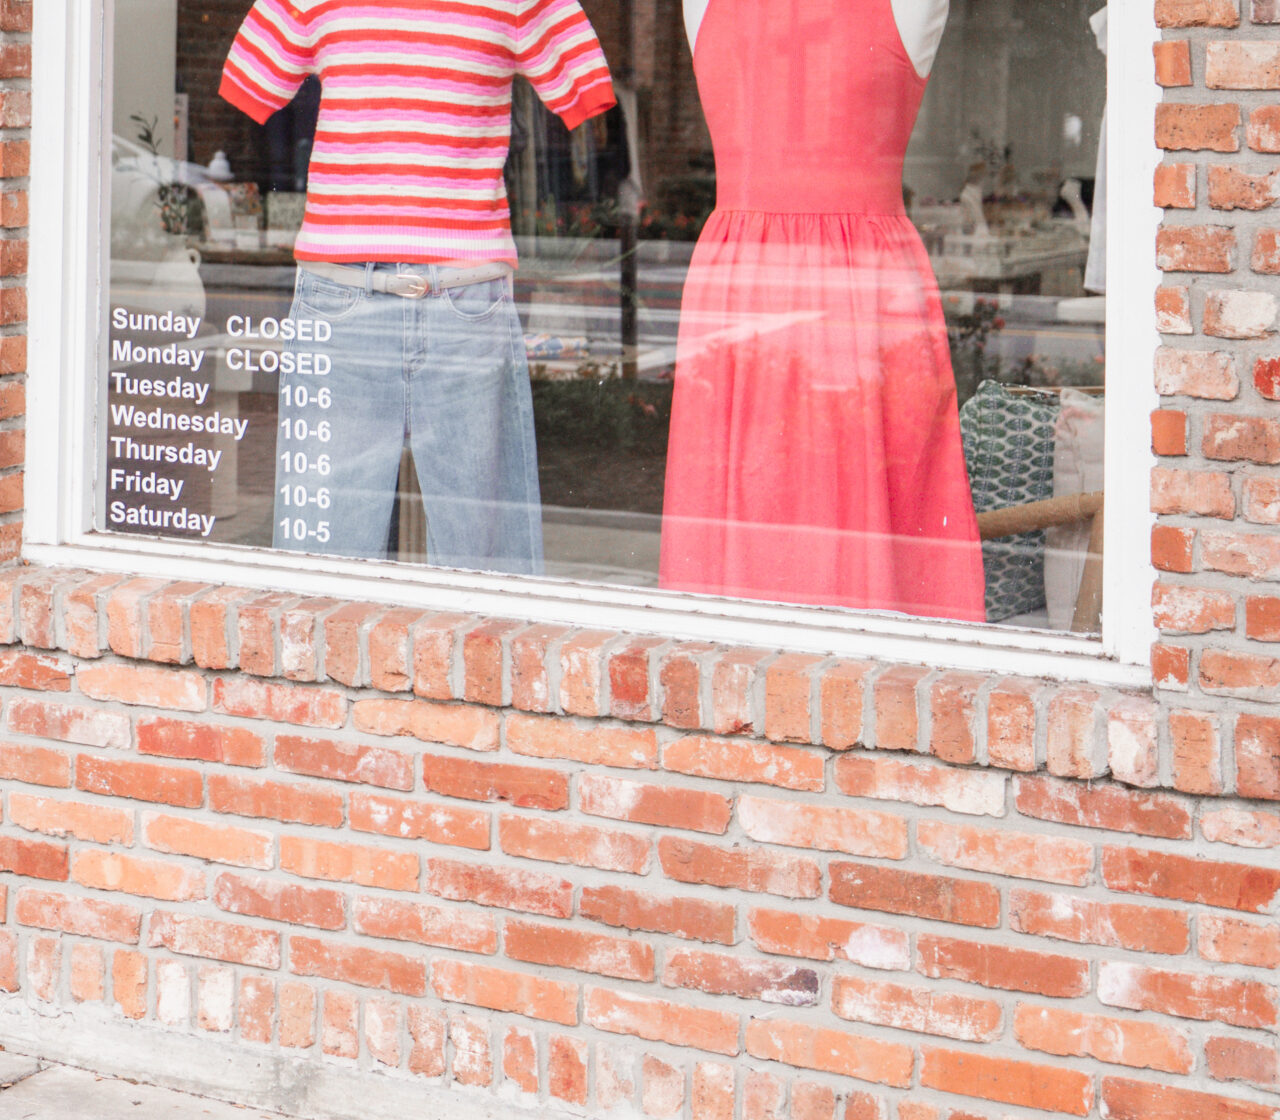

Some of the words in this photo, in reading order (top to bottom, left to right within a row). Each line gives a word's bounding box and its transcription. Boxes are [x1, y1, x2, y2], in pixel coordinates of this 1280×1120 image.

[112, 307, 201, 338] Sunday
[226, 315, 332, 342] CLOSED
[112, 340, 205, 372] Monday
[226, 348, 332, 375] CLOSED
[111, 372, 209, 404] Tuesday
[281, 385, 332, 409] 10-6
[111, 405, 248, 440] Wednesday
[281, 418, 332, 442] 10-6
[111, 437, 222, 471] Thursday
[280, 451, 331, 475] 10-6
[111, 469, 184, 500] Friday
[280, 484, 331, 509] 10-6
[110, 501, 215, 536] Saturday
[279, 517, 331, 542] 10-5
